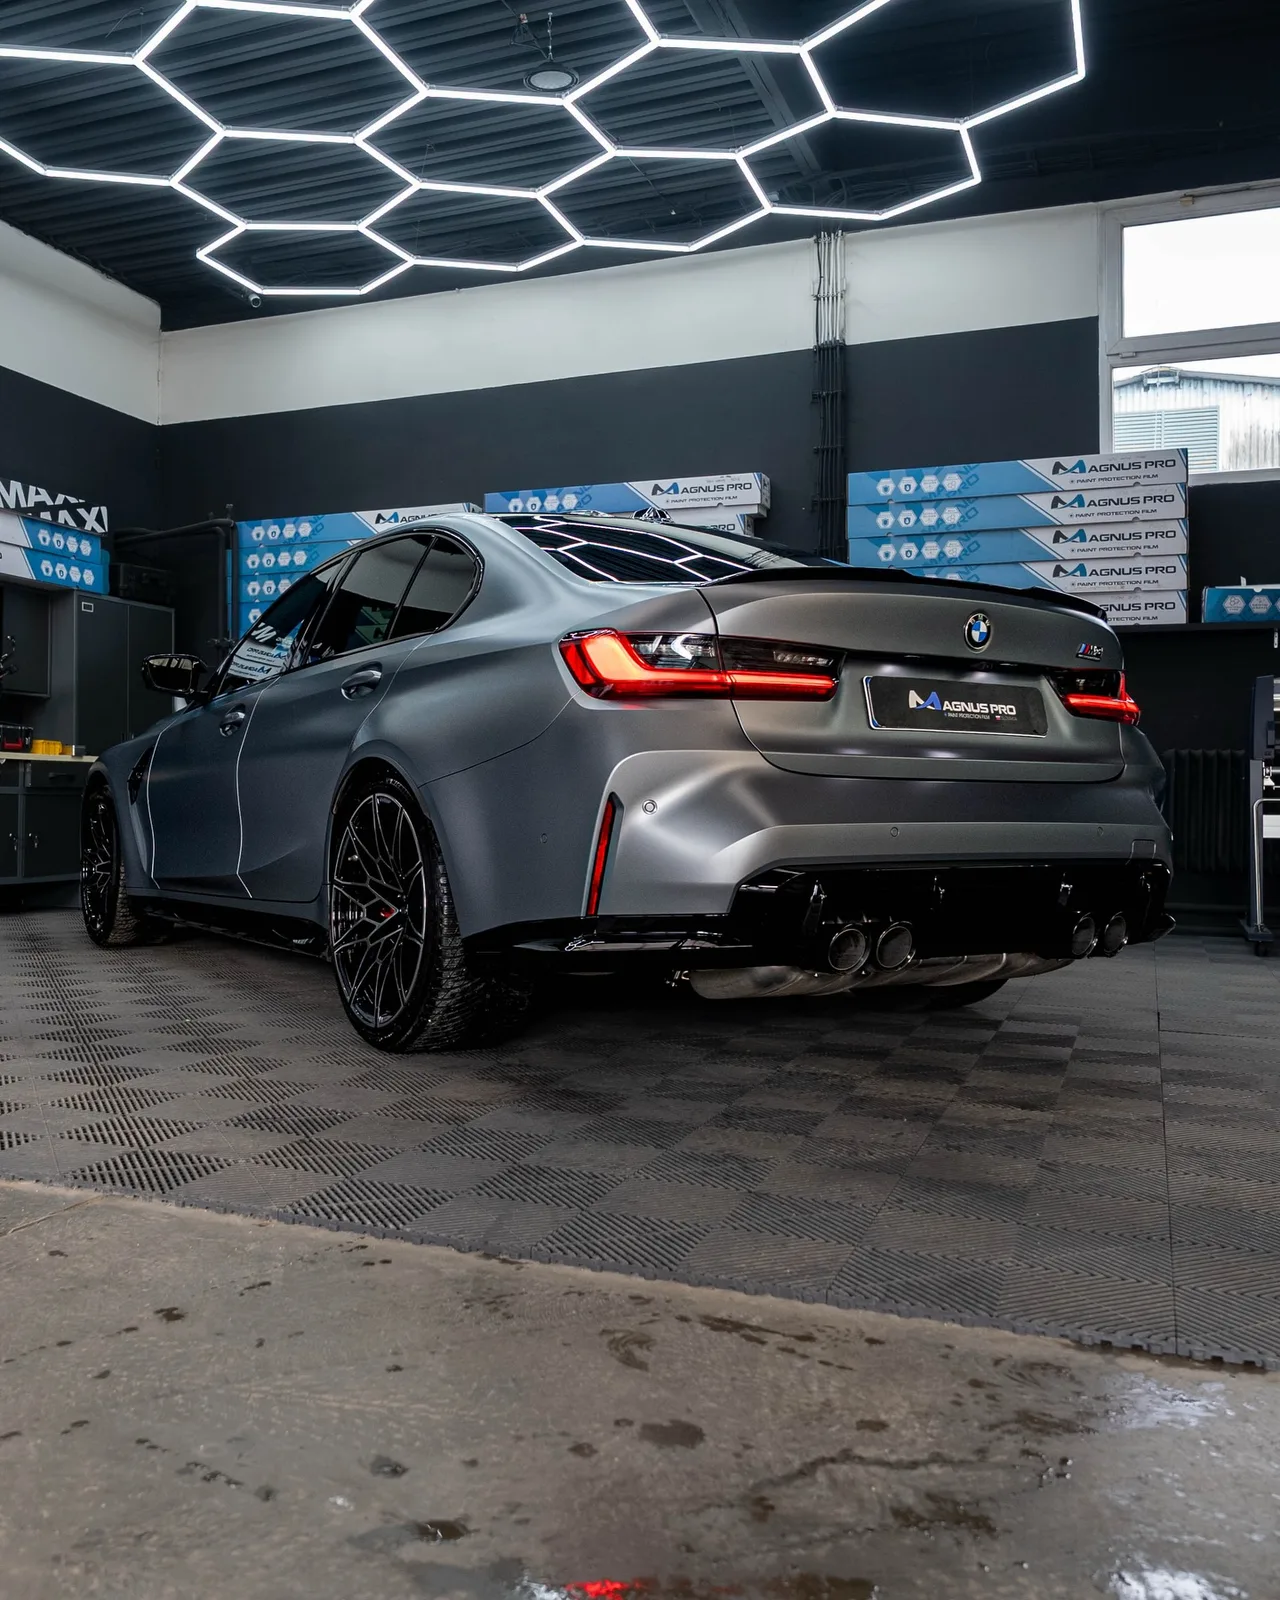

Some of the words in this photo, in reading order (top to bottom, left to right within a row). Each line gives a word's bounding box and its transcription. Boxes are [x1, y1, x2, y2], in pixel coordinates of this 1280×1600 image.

[1052, 459, 1142, 475] MAGNUS
[1144, 459, 1176, 469] PRO
[651, 482, 725, 496] MAGNUS
[726, 482, 752, 491] PRO
[1051, 493, 1140, 509] MAGNUS
[1143, 494, 1175, 504] PRO
[1052, 528, 1142, 544] MAGNUS
[1145, 530, 1176, 539] PRO
[1052, 563, 1142, 578] MAGNUS
[1145, 565, 1176, 575] PRO
[1099, 602, 1142, 612] GNUS
[1144, 601, 1176, 611] PRO
[908, 690, 990, 713] MAGNUS
[989, 704, 1017, 715] PRO
